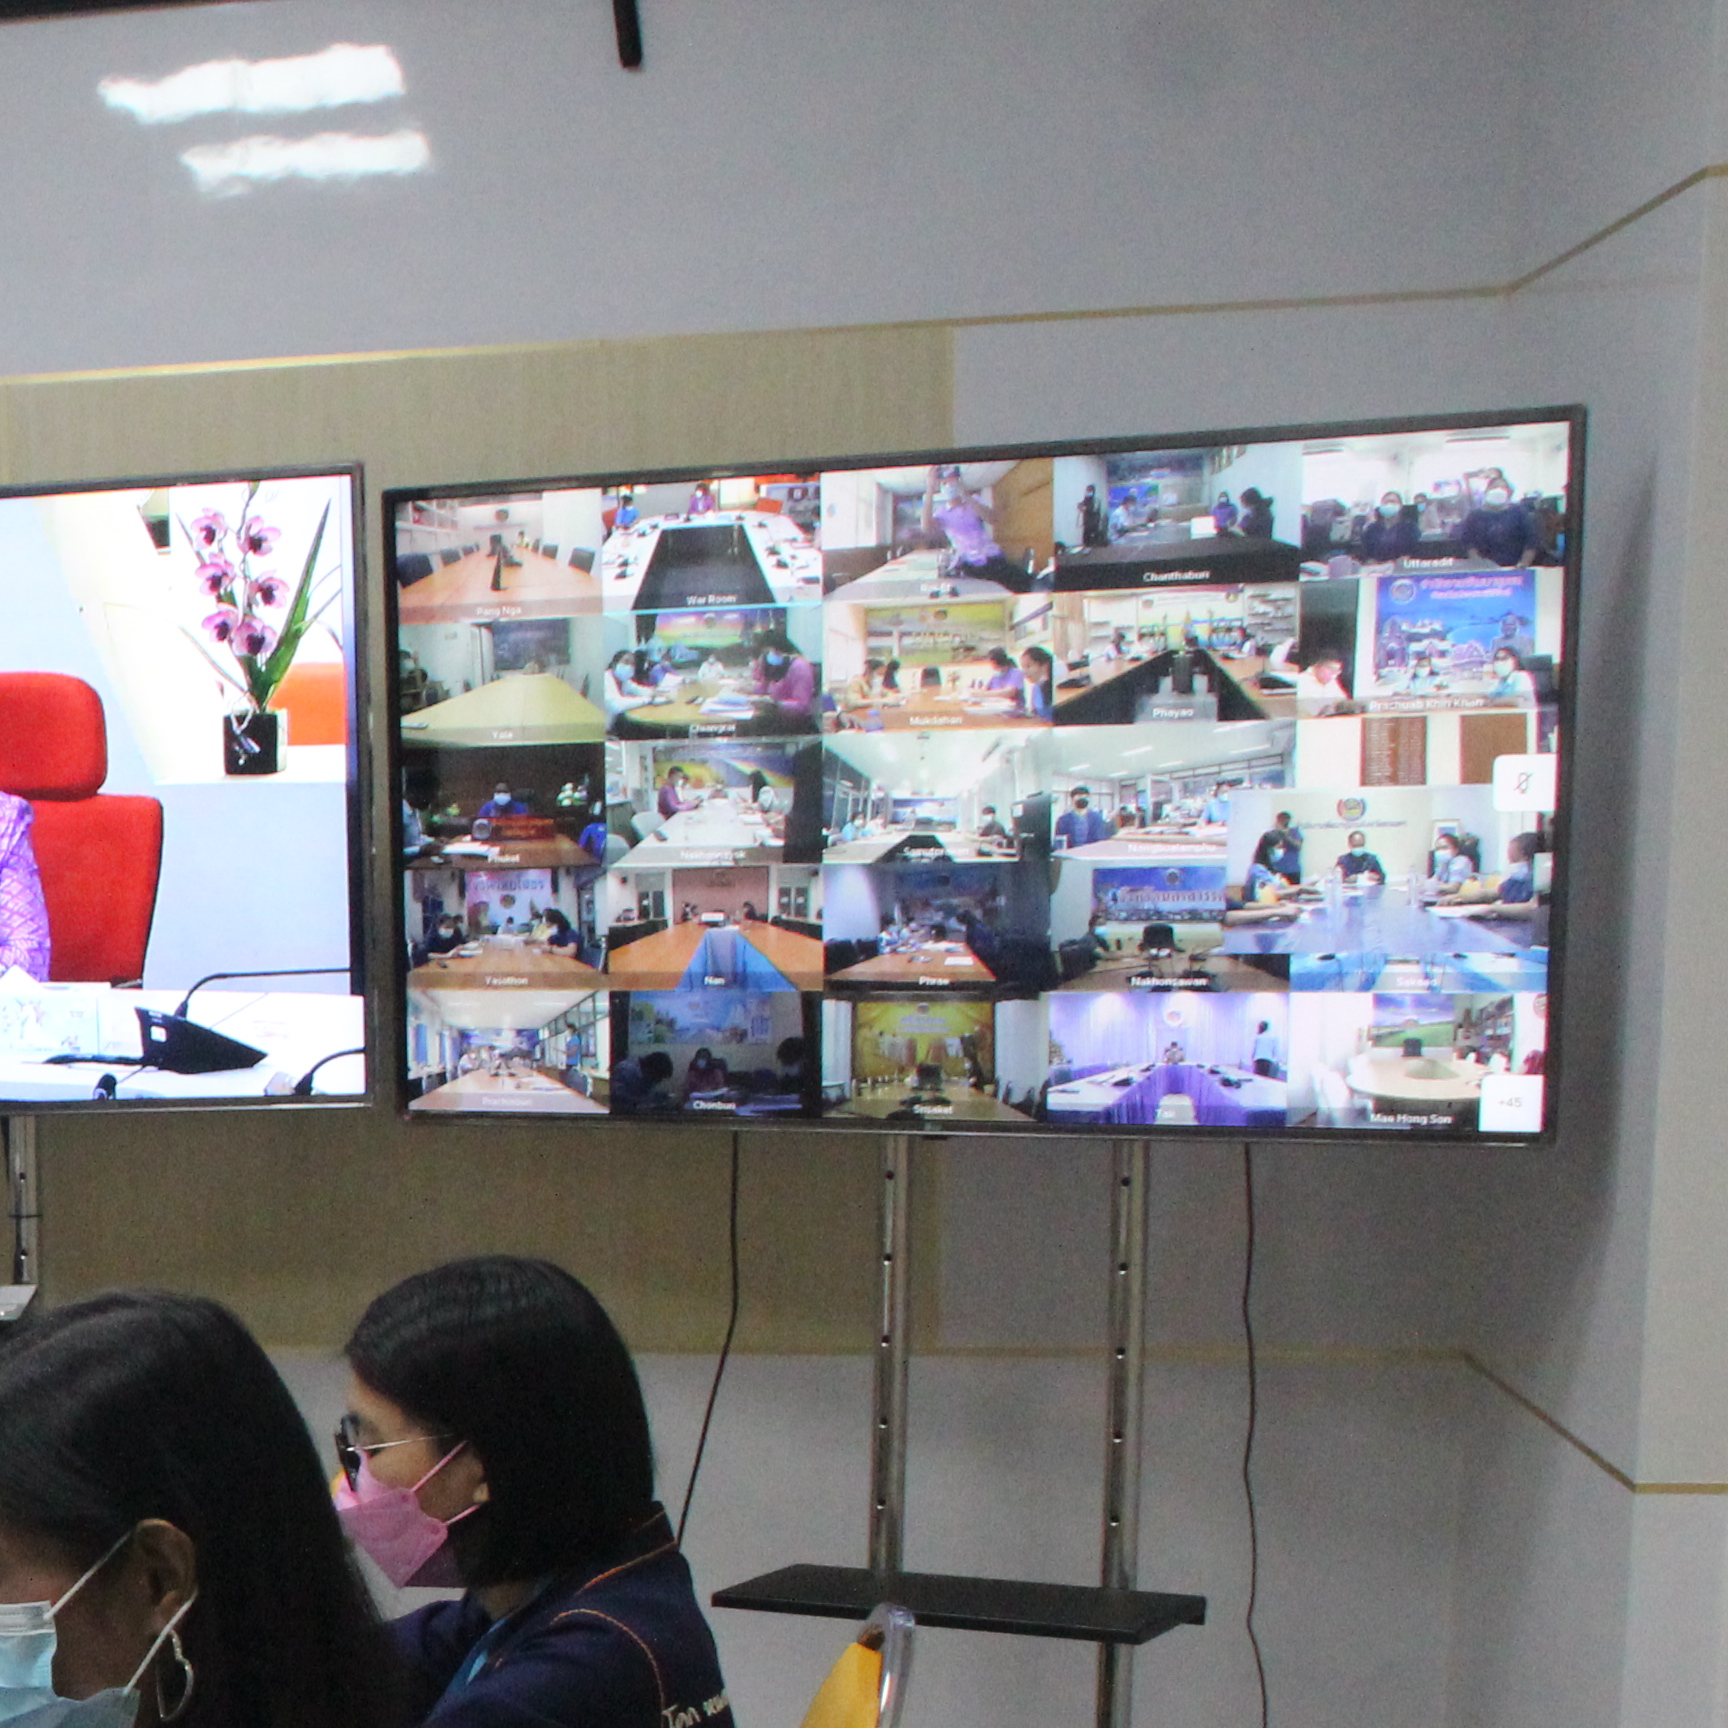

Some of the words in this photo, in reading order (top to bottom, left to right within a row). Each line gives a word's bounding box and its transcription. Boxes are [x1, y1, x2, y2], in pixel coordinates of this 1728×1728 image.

[686, 595, 706, 606] War
[708, 594, 738, 604] Room
[1152, 707, 1194, 719] Phayao
[703, 975, 726, 986] Nan
[1370, 1113, 1395, 1124] Mae
[1396, 1113, 1429, 1126] Hong
[1429, 1113, 1453, 1124] Son
